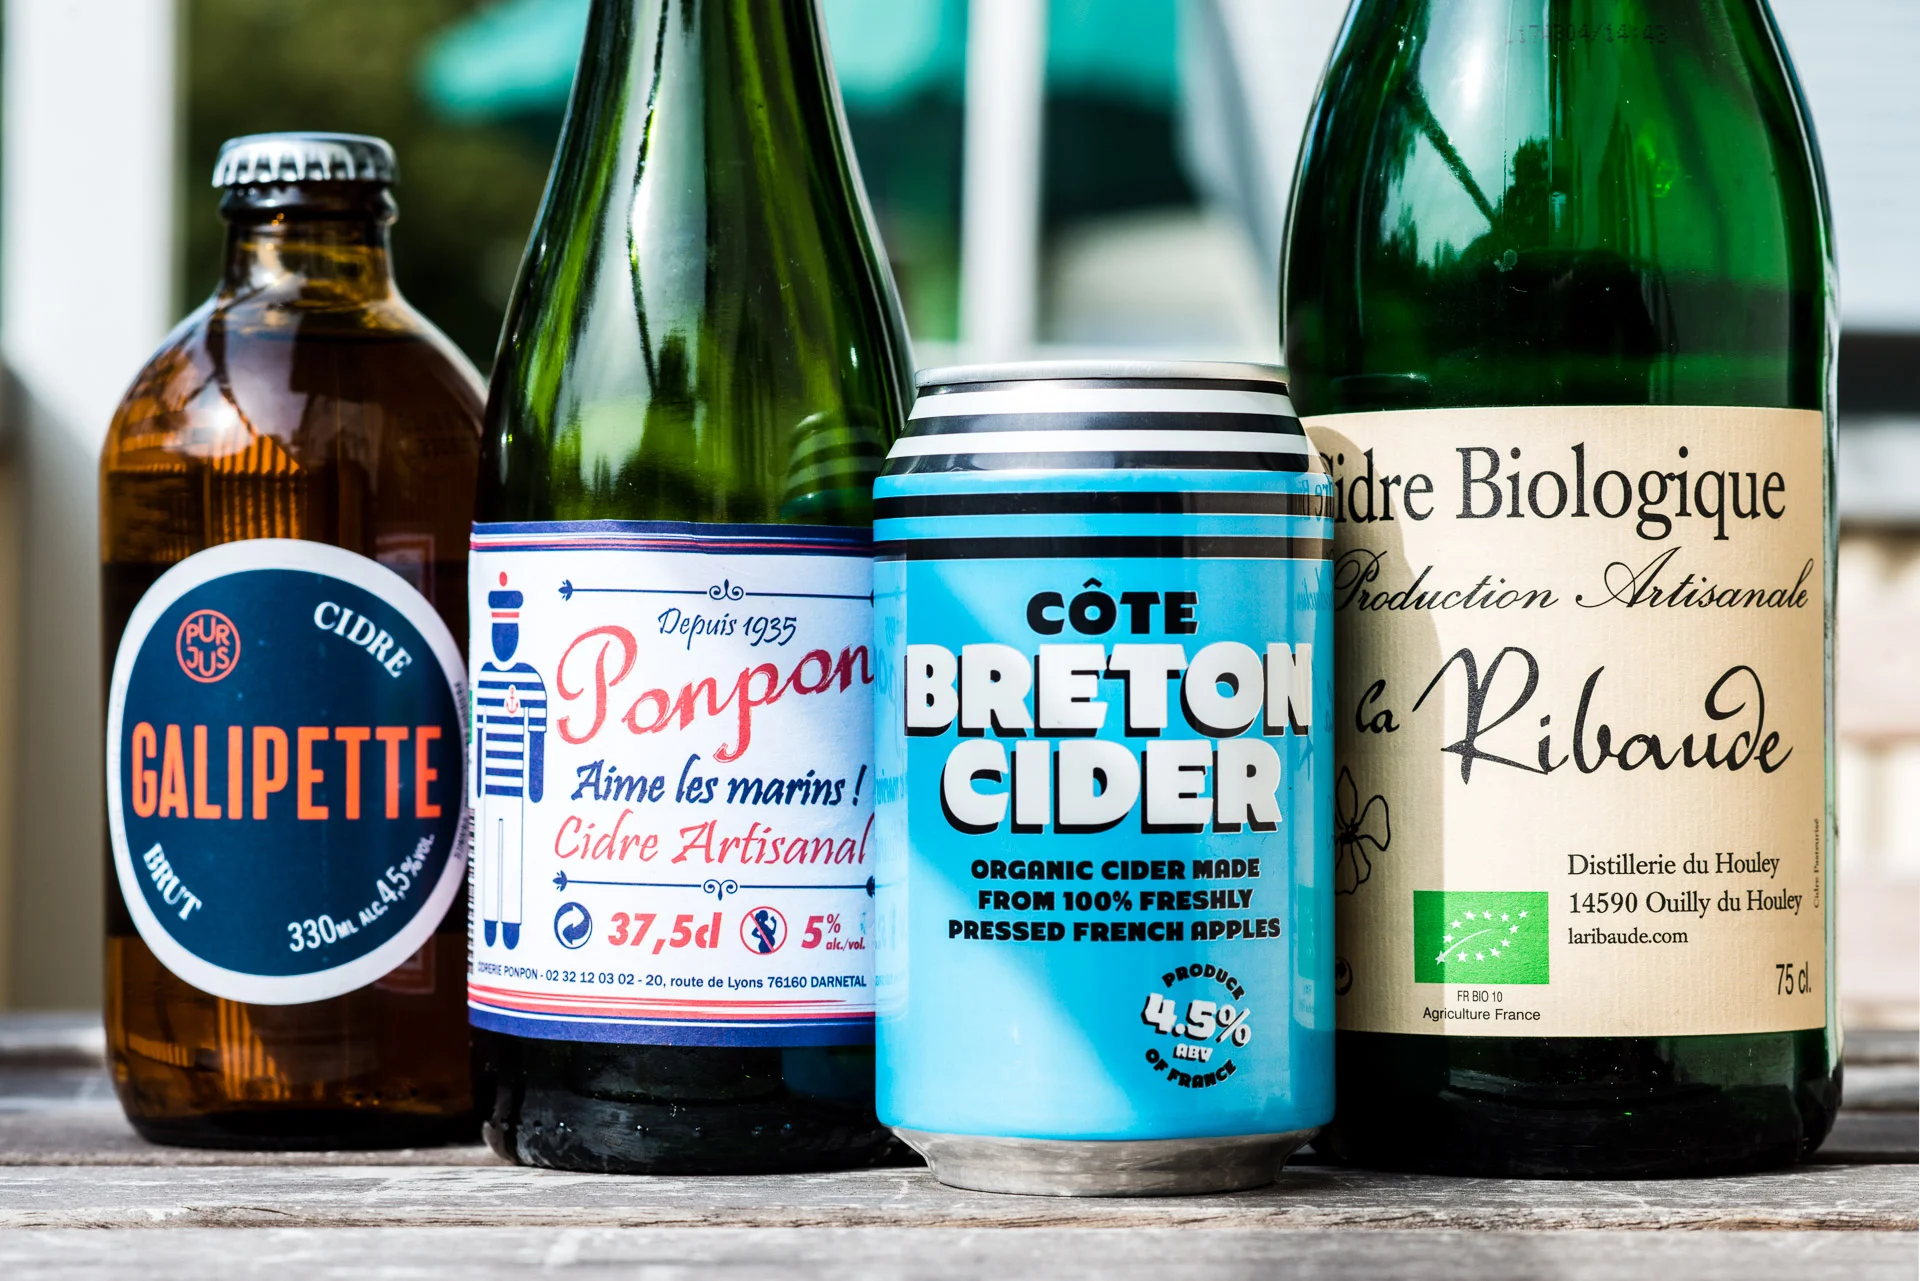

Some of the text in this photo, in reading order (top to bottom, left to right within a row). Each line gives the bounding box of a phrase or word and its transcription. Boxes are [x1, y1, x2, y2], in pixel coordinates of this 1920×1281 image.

[1319, 447, 1434, 524] idre
[1456, 442, 1786, 541] Biologique
[1334, 547, 1560, 612] Production
[1575, 546, 1815, 610] Artisanale
[1026, 577, 1198, 635] CÔTE
[186, 616, 231, 646] PUR
[313, 600, 412, 677] CIDRE
[658, 607, 797, 650] Depuis 1935
[185, 646, 231, 677] JUS
[556, 625, 874, 763] Ponpon
[904, 641, 1313, 738] BRETON
[1412, 646, 1794, 786] Ribaude
[132, 722, 442, 819] GALIPETTE
[571, 759, 666, 803] Aime
[676, 754, 718, 804] les
[728, 770, 845, 806] marins
[940, 738, 1283, 835] CIDER
[554, 809, 875, 866] Cidre Artisanal
[143, 843, 203, 921] BRUT
[971, 858, 1260, 880] ORGANIC CIDER MADE
[1567, 850, 1781, 880] Distillerie du Houley
[978, 888, 1253, 912] FROM 100% FRESHLY
[1569, 889, 1804, 920] 14590 Ouilly du Houley
[948, 917, 1281, 942] PRESSED FRENCH APPLES
[1568, 926, 1689, 946] laribaude.com
[504, 965, 538, 980] PONPON
[545, 969, 560, 982] 02
[562, 970, 576, 983] 32
[580, 971, 595, 984] 12
[598, 972, 614, 985] 03
[618, 973, 635, 986] 02
[645, 974, 667, 988] 20,
[670, 975, 705, 988] route
[708, 974, 724, 988] de
[728, 975, 763, 990] Lyons
[767, 976, 806, 989] 76160
[811, 975, 867, 989] DARNETAL
[1162, 963, 1246, 1001] PRODUCE
[1457, 990, 1503, 1003] FR BIO 10
[1775, 961, 1812, 996] 75 cl.
[1141, 992, 1252, 1048] 4.5%
[1423, 1006, 1541, 1023] Agriculture France
[1145, 1048, 1237, 1089] OF FRANCE
[1172, 1043, 1213, 1063] ABV
